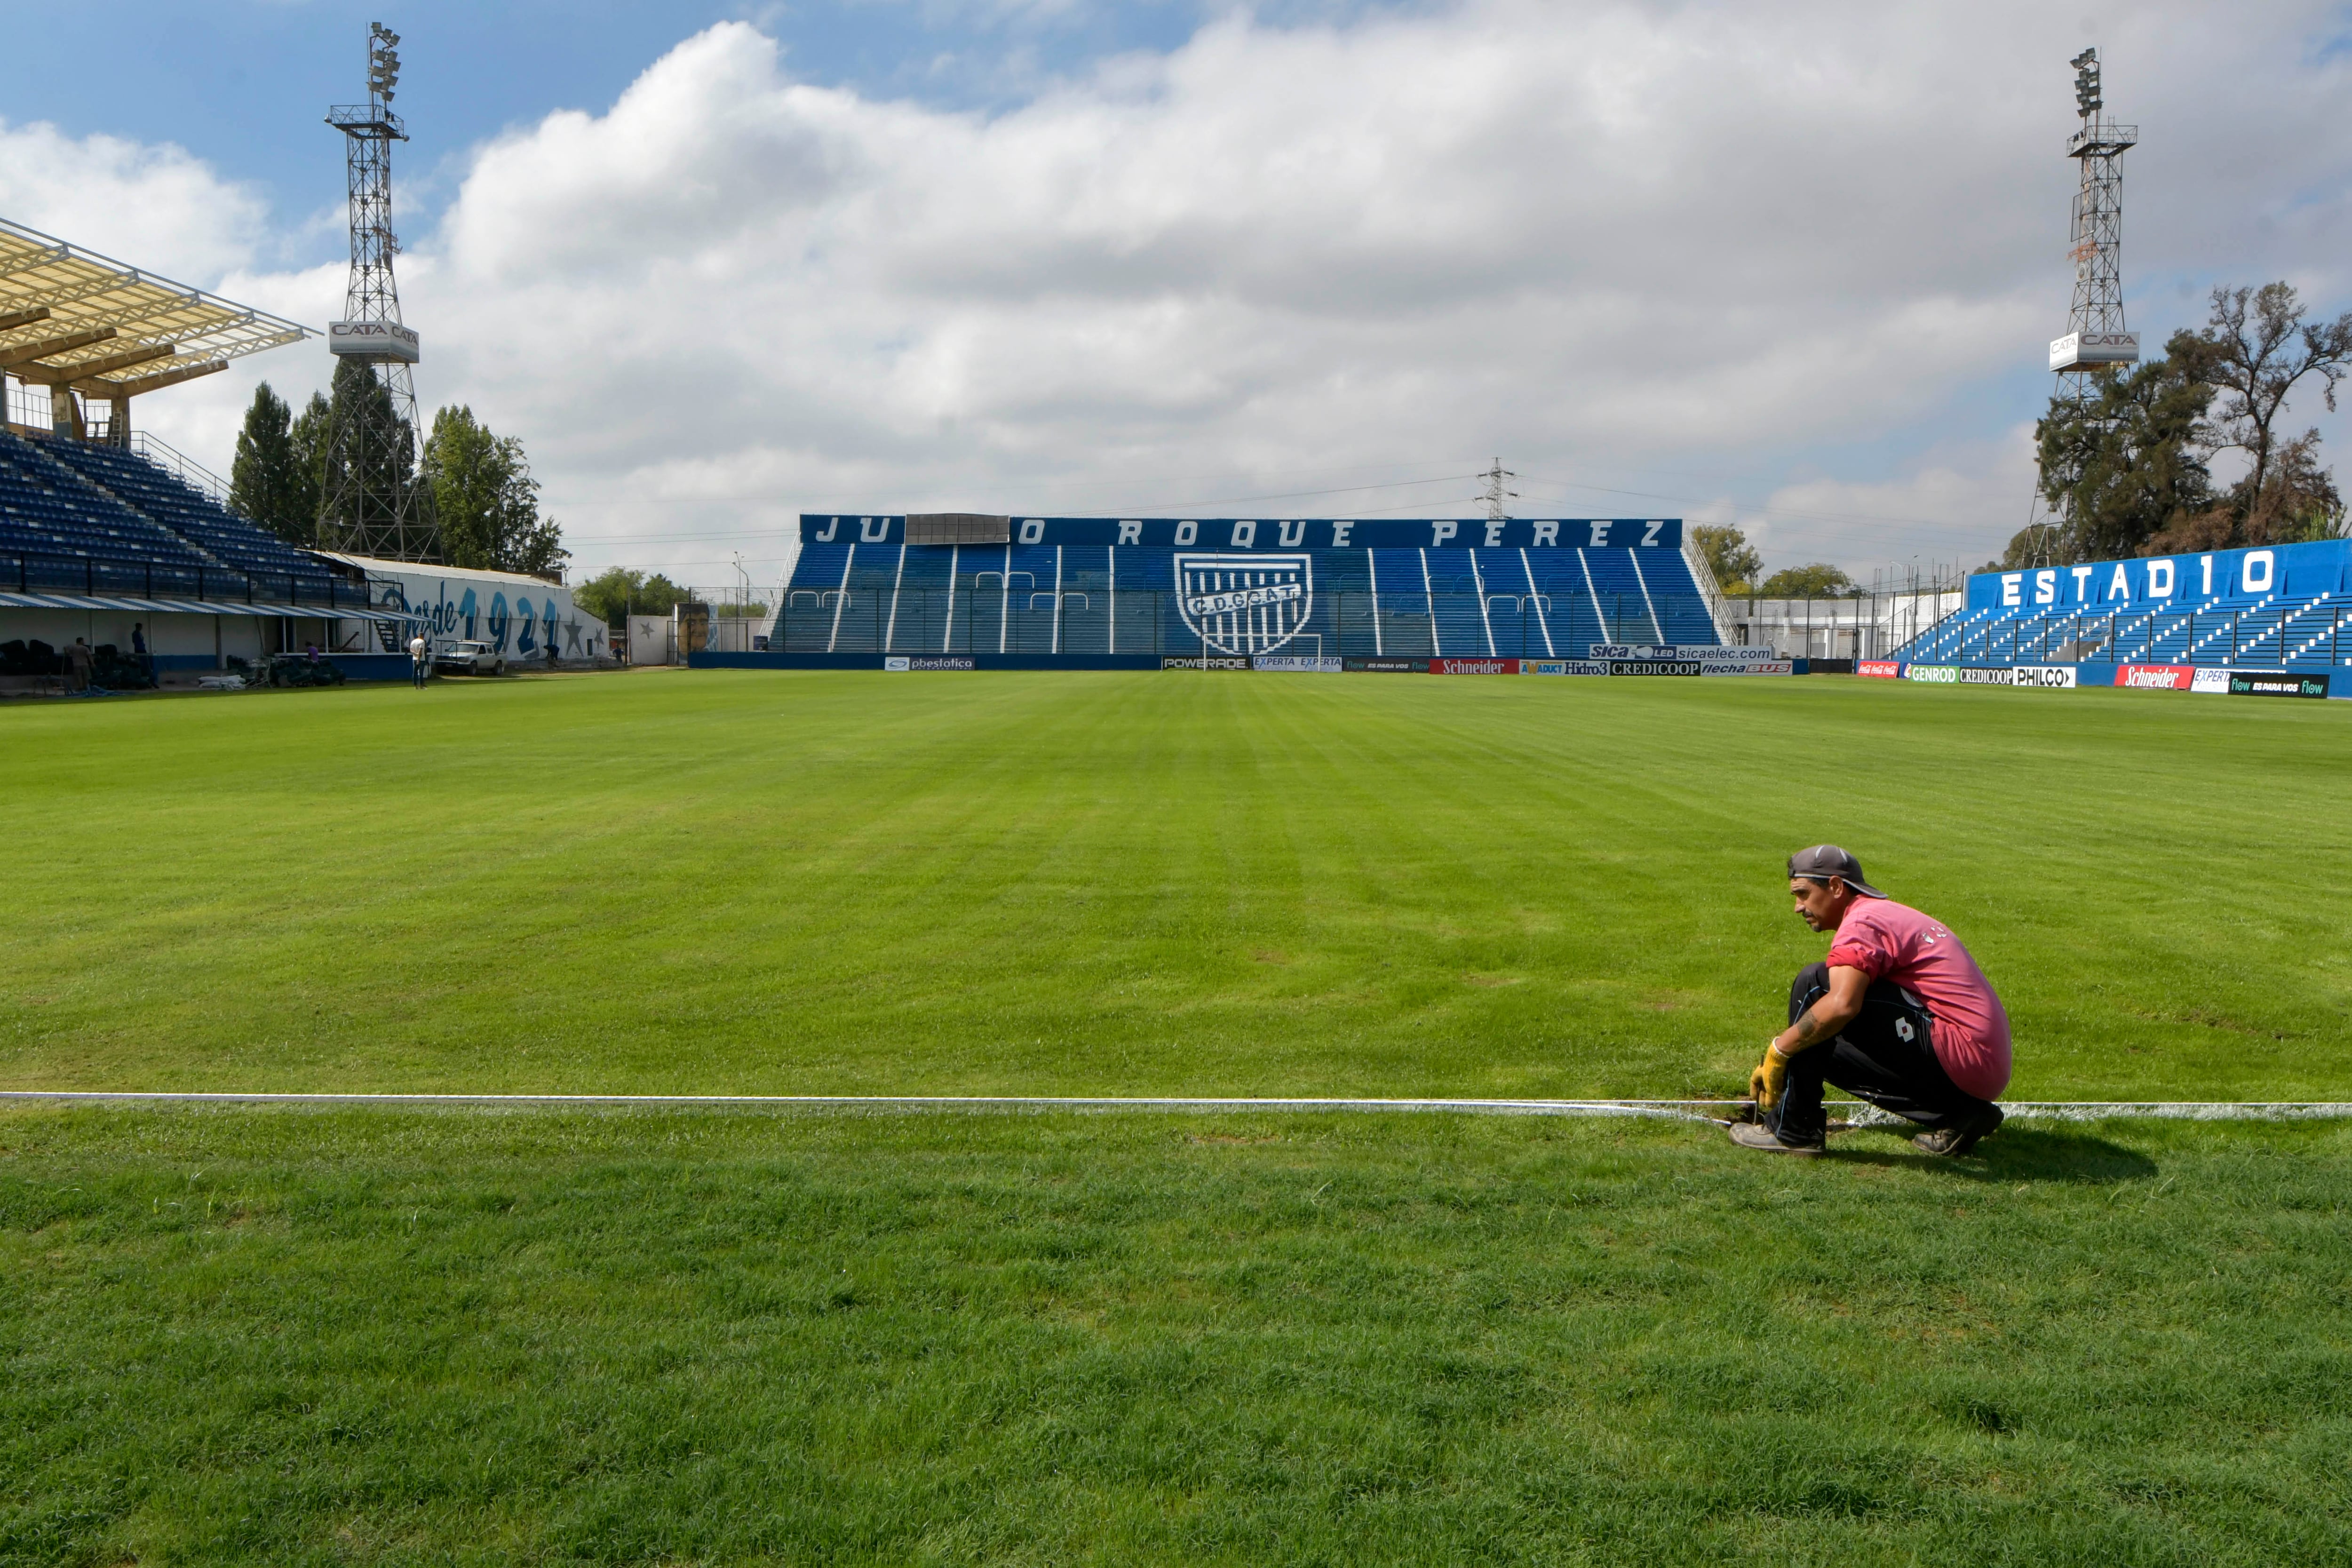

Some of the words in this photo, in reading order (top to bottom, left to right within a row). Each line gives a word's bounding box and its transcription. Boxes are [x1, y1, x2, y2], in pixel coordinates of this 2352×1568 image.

[331, 324, 388, 335] CATA
[392, 326, 418, 346] CATA
[2051, 337, 2077, 354] CATA
[2081, 334, 2137, 345] CATA
[816, 517, 1045, 544] JUO
[1117, 520, 1355, 548] ROQUE
[1431, 521, 1664, 547] PEREZ
[2001, 550, 2274, 606] ESTADIO
[458, 587, 558, 655] 1921
[1678, 648, 1770, 659] sicaelec.com
[1164, 658, 1246, 669] POWERADE
[1255, 658, 1295, 669] EXPERTA
[1301, 658, 1341, 669] EXPERTA
[1443, 660, 1505, 674] Schneider
[1522, 661, 1563, 674] AWADUCT
[1612, 662, 1699, 675] CREDICOOP
[1913, 667, 1956, 683] GENROD
[1960, 669, 2012, 685] CREDICOOP
[2018, 669, 2064, 686] PHILCO
[2125, 666, 2179, 688] Schneider
[2232, 678, 2249, 691] flow
[2283, 684, 2298, 692] VOS
[2302, 680, 2323, 694] flow
